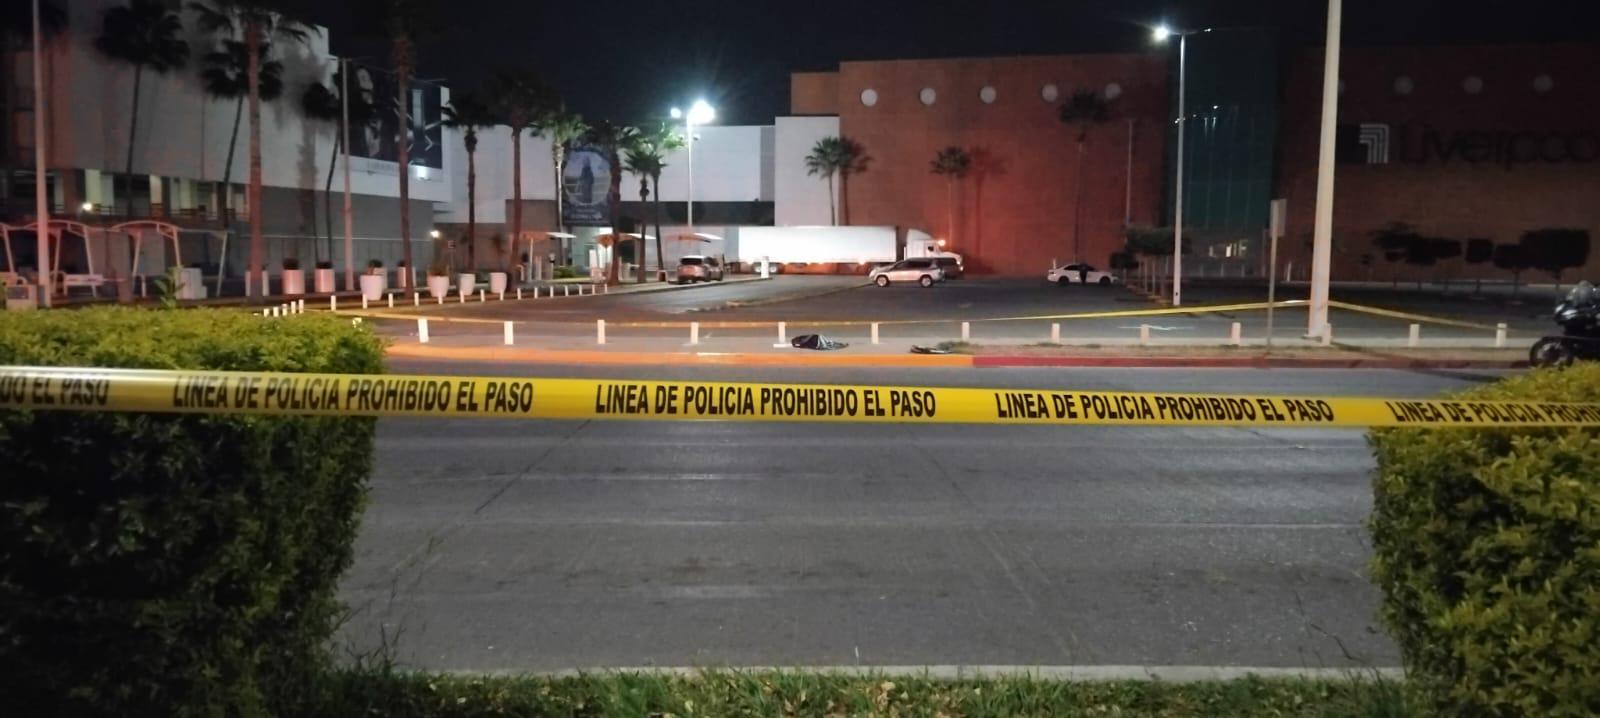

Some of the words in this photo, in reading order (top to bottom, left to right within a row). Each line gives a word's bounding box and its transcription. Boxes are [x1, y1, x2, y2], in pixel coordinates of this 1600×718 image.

[32, 376, 55, 405] EL
[61, 377, 109, 406] PASO
[173, 376, 228, 408] LINEA
[234, 377, 262, 408] DE
[264, 378, 339, 410] POLICIA
[346, 379, 451, 412] PROHIBIDO
[456, 381, 478, 412] EL
[484, 382, 533, 413] PASO
[595, 384, 648, 414] LINEA
[654, 385, 678, 414] DE
[683, 386, 755, 415] POLICIA
[760, 387, 858, 416] PROHIBIDO
[863, 389, 885, 417] EL
[890, 390, 936, 417] PASO
[995, 393, 1050, 418] LINEA
[1051, 394, 1078, 419] DE
[1079, 394, 1154, 420] POLICIA
[1153, 396, 1256, 421] PROHIBIDO
[1255, 398, 1285, 421] EL
[1282, 399, 1334, 422] PASO
[1384, 401, 1447, 422] LINEA
[1440, 402, 1473, 422] DE
[1470, 402, 1545, 423] POLICIA
